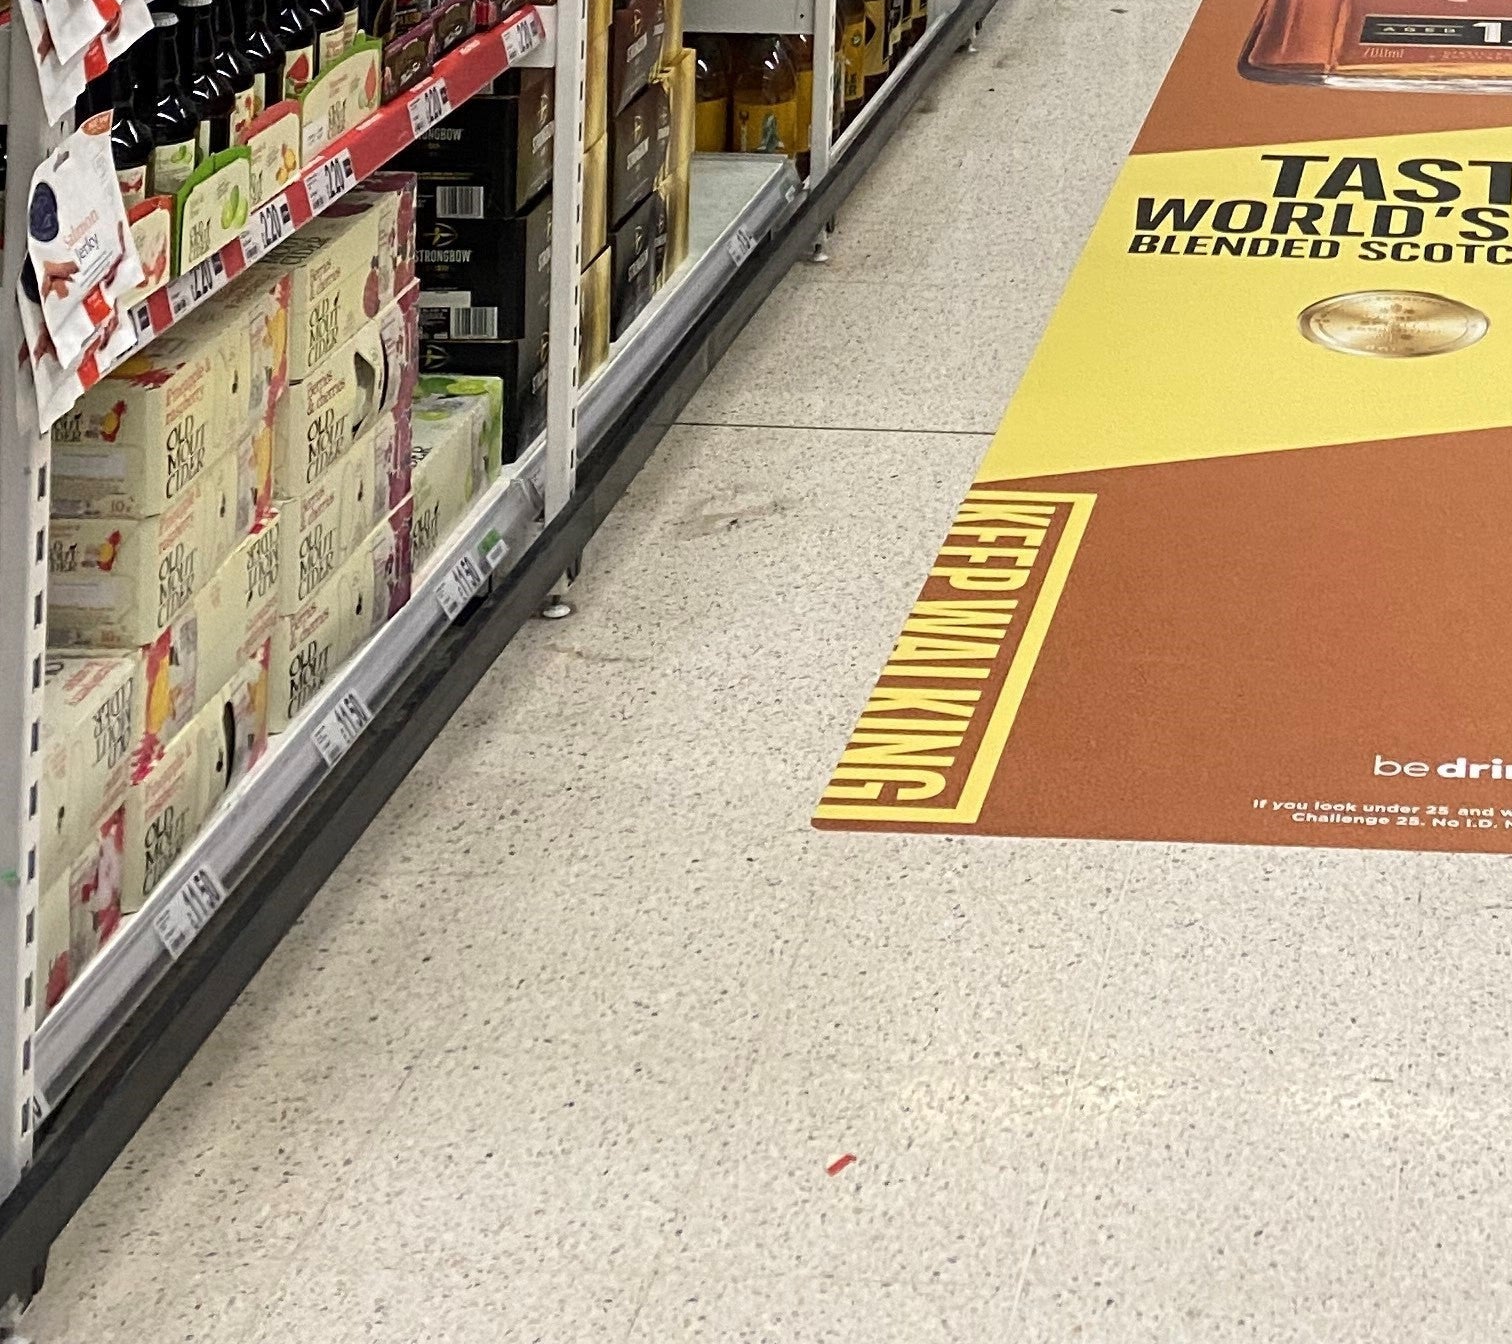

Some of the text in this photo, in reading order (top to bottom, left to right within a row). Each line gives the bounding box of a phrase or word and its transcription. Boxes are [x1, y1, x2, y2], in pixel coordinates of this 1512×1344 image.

[1134, 198, 1510, 244] WORLD'S
[1127, 234, 1340, 261] BLENDED
[822, 503, 1056, 801] KEEP WALKING
[1253, 799, 1266, 809] If
[1272, 801, 1308, 813] you
[1314, 801, 1356, 812] look
[1363, 804, 1420, 814] under
[1425, 805, 1449, 815] 25
[1458, 806, 1494, 817] and
